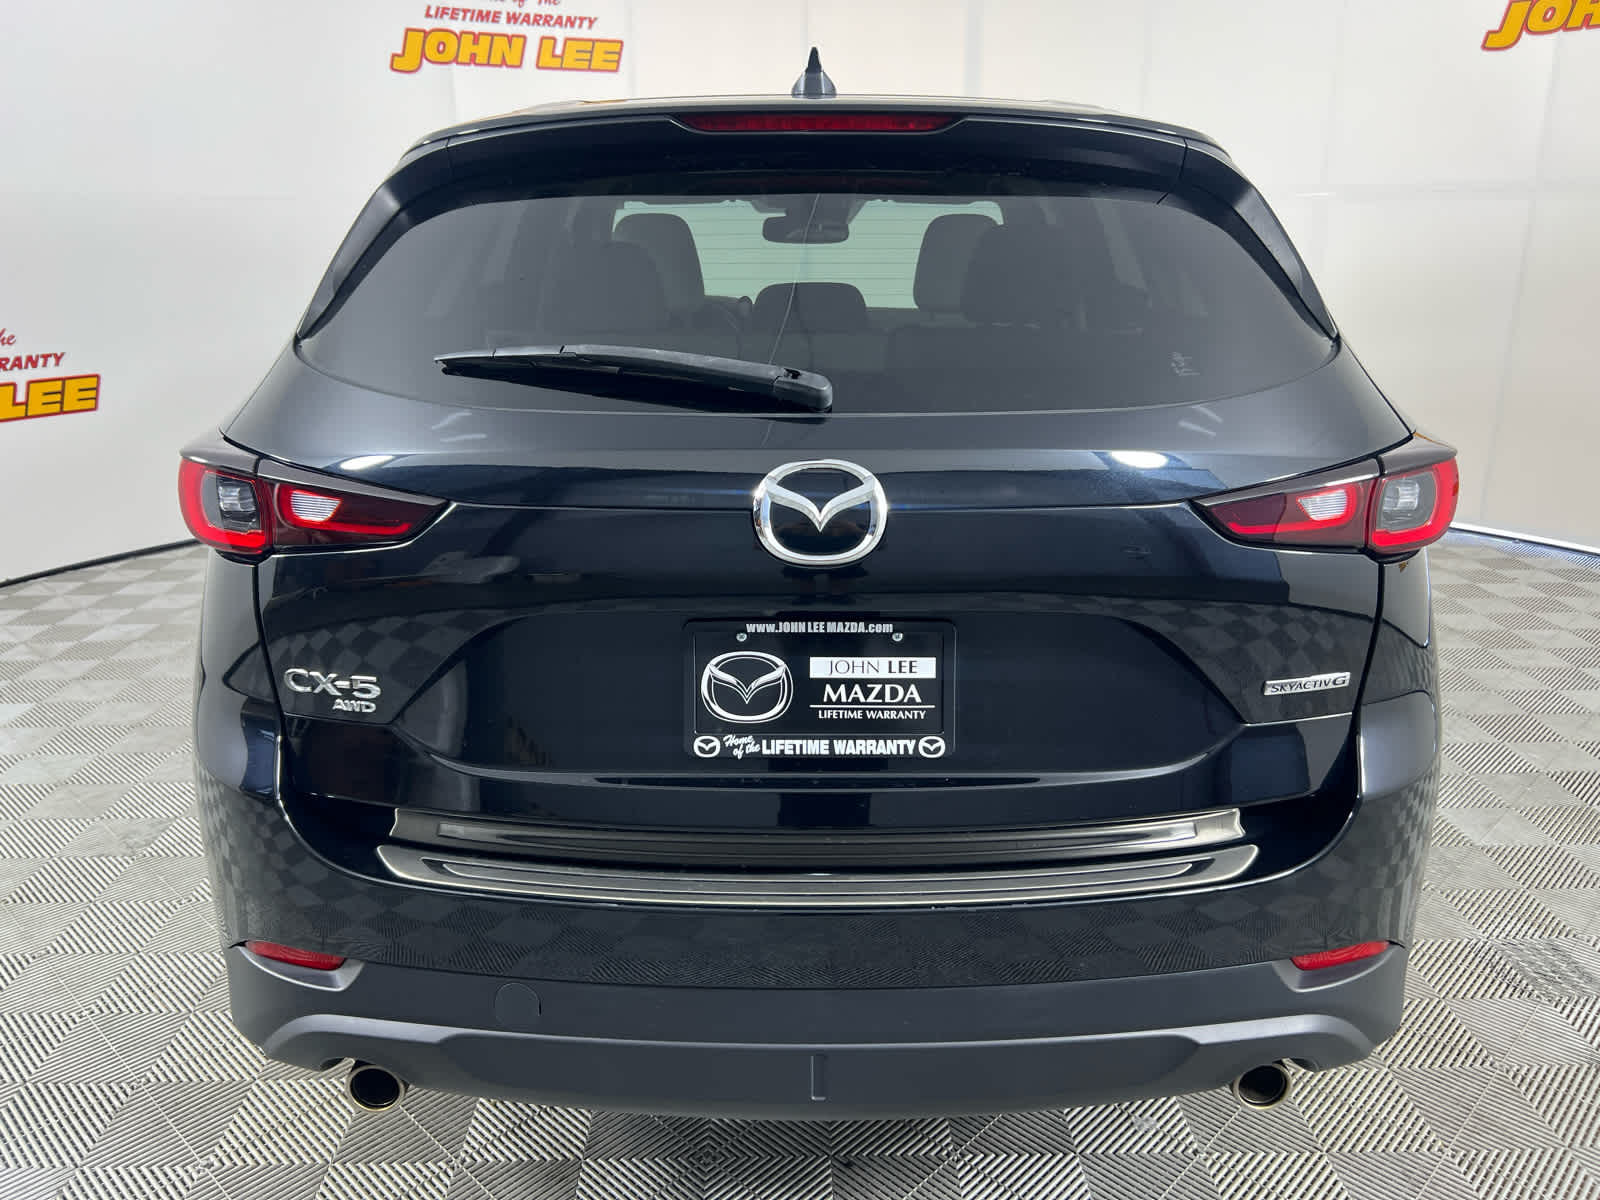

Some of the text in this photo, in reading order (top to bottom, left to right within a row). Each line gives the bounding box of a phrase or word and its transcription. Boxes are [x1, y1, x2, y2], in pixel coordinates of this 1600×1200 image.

[424, 5, 598, 29] LIFETIME WARRANTY
[390, 27, 624, 74] JOHN LEE
[0, 374, 100, 423] LEE
[746, 622, 893, 633] www.JOHN LEE MAZDA.com
[828, 660, 918, 676] JOHN LEE
[284, 668, 381, 699] CX-5
[823, 684, 922, 703] MAZDA
[332, 699, 376, 712] AWD
[818, 710, 926, 720] LIFETIME WARRANTY
[723, 734, 755, 748] Home
[762, 740, 916, 755] LIFETIME WARRANTY
[733, 741, 760, 760] of the
